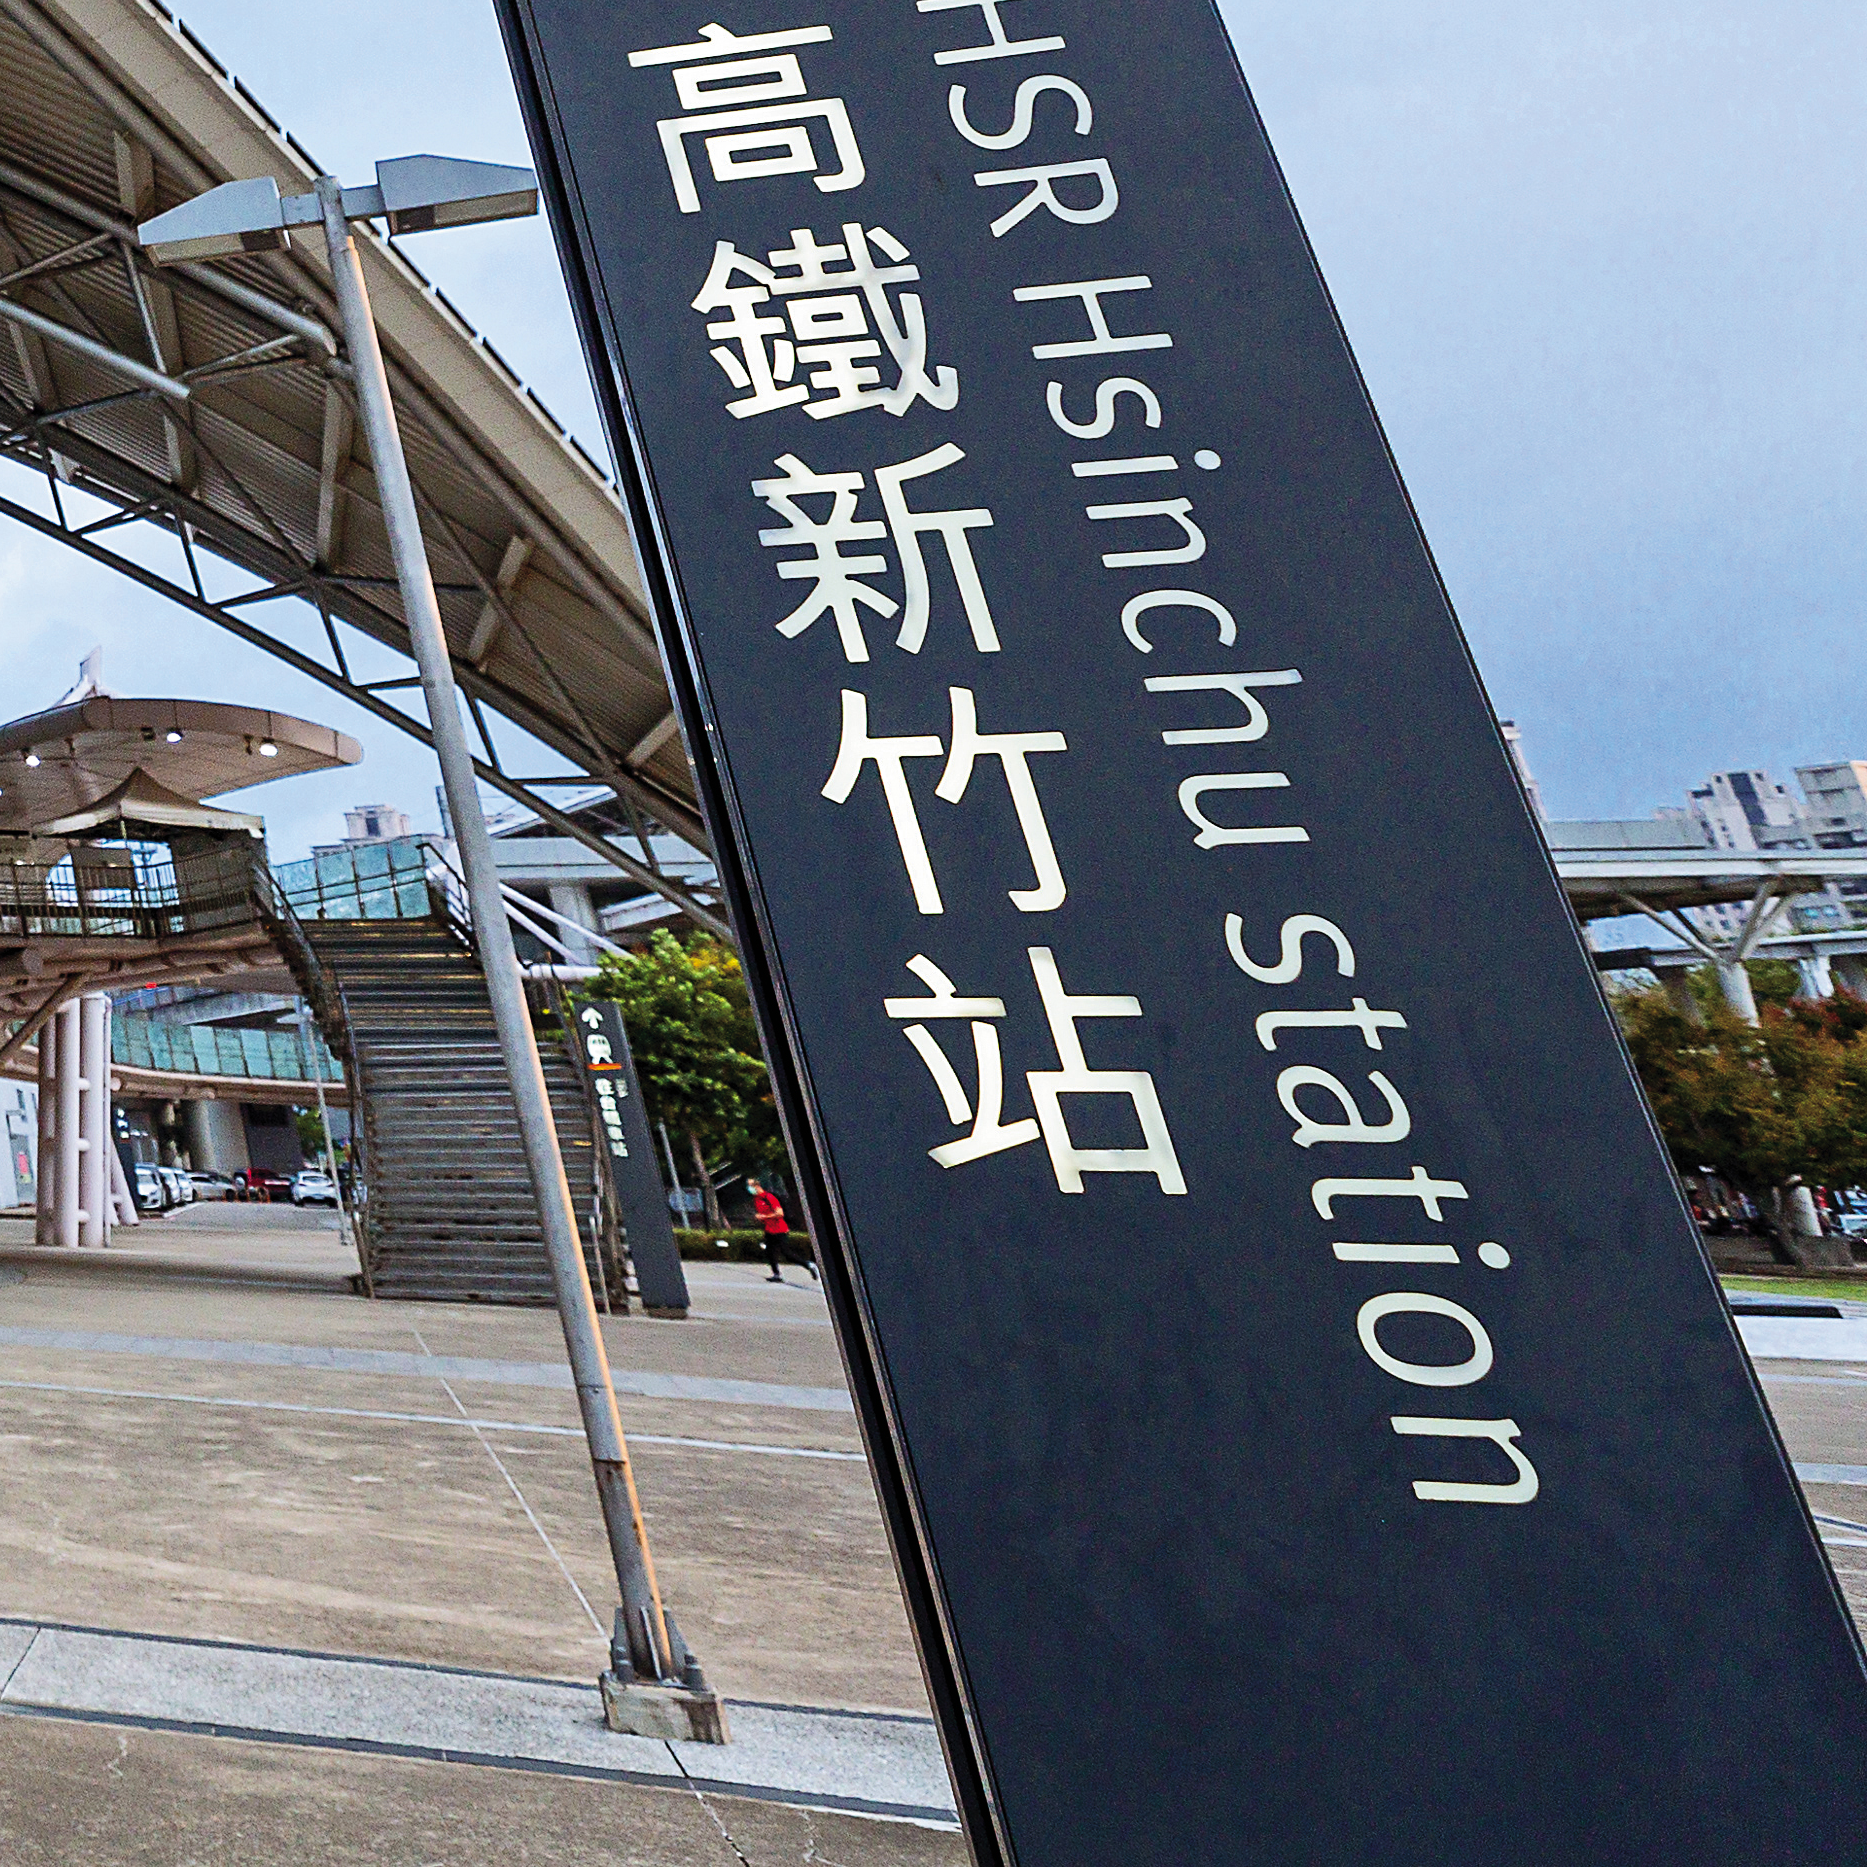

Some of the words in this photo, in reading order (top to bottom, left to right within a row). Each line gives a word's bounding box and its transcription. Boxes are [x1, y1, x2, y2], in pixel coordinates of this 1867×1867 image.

[626, 21, 1189, 1196] 高鐵新竹站
[1011, 274, 1311, 851] Hsinchu
[1224, 911, 1540, 1505] station
